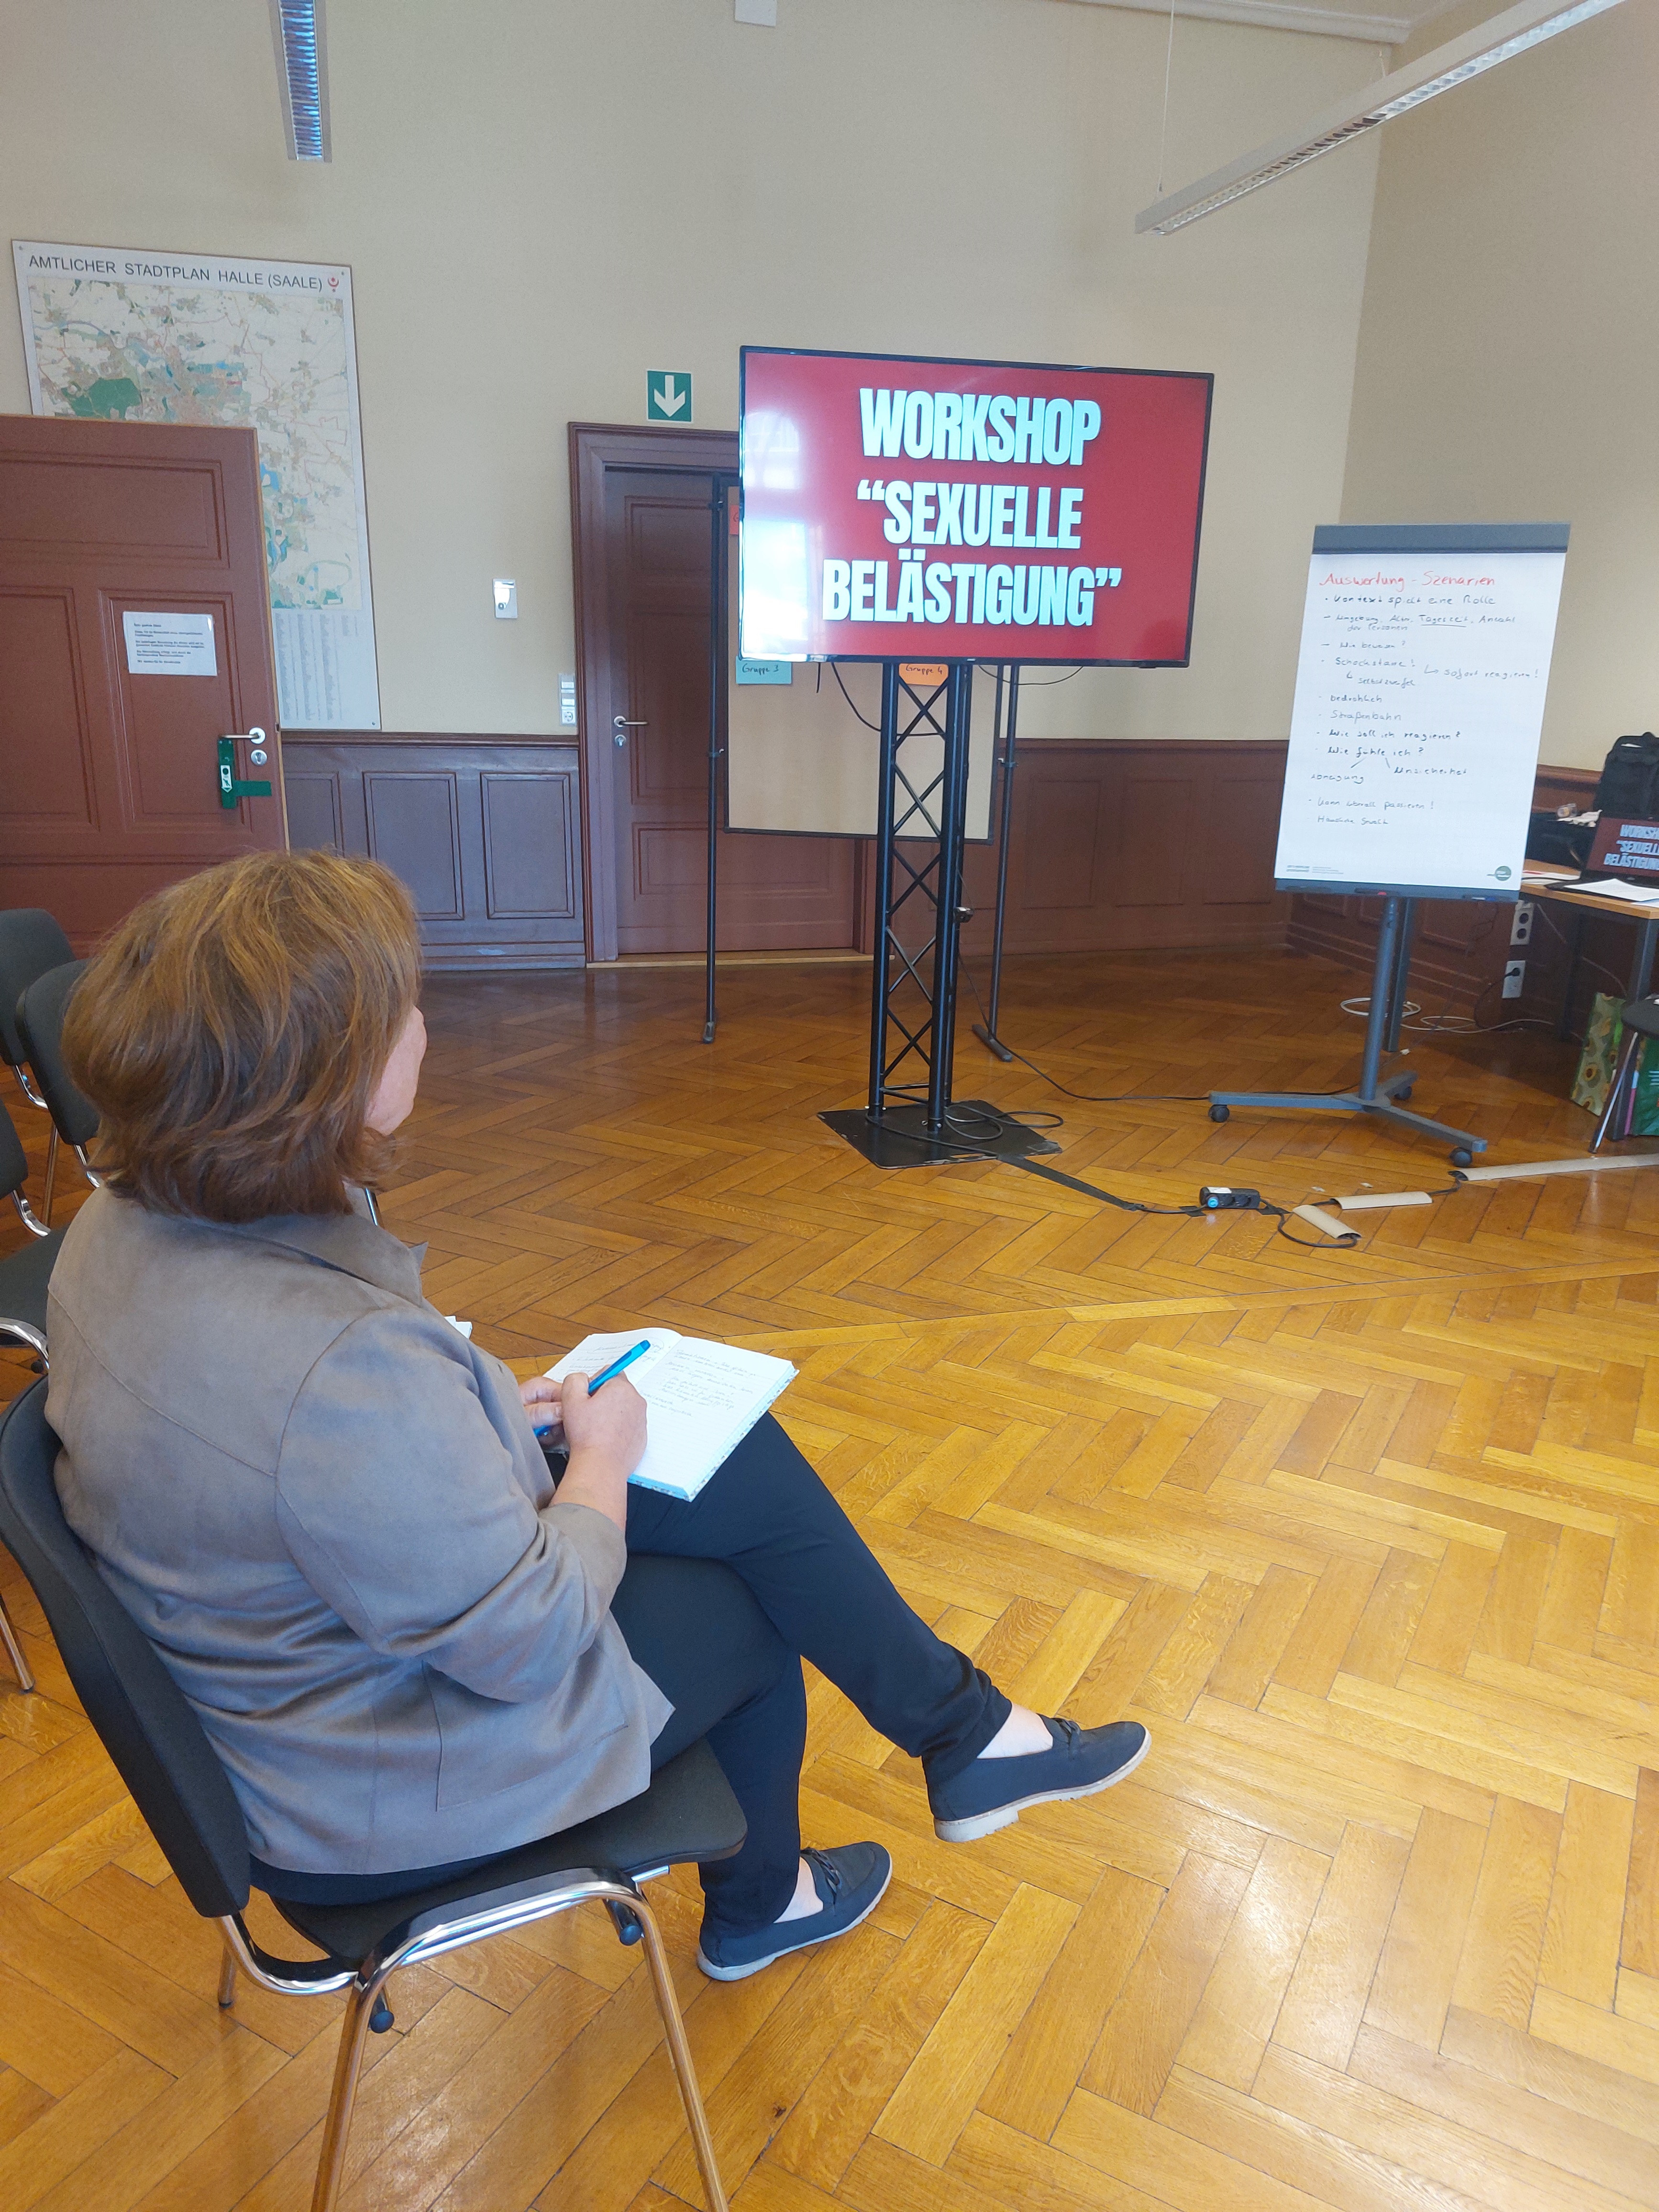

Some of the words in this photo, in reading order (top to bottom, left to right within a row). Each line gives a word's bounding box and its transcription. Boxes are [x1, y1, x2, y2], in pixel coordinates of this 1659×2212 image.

[29, 255, 117, 274] AMTLICHER
[124, 263, 210, 281] STADTPLAN
[218, 269, 264, 286] HALLE
[268, 273, 323, 292] (SAALE)
[860, 388, 1102, 465] WORKSHOP
[856, 479, 1084, 549] “SEXUELLE
[822, 548, 1122, 626] BELÄSTIGUNG”
[1319, 572, 1405, 592] Auswertung
[1422, 571, 1495, 586] Szenarien
[1388, 597, 1421, 608] spielt
[1463, 595, 1496, 605] Rolle
[1368, 623, 1408, 631] Personen
[742, 663, 770, 676] Gruppe
[773, 664, 779, 672] 3
[906, 664, 934, 675] Gruppe
[938, 666, 942, 675] 4
[1444, 668, 1479, 680] sofort
[1330, 710, 1402, 725] Straßenbahn
[1329, 729, 1349, 737] Wie
[1356, 747, 1385, 758] fühle
